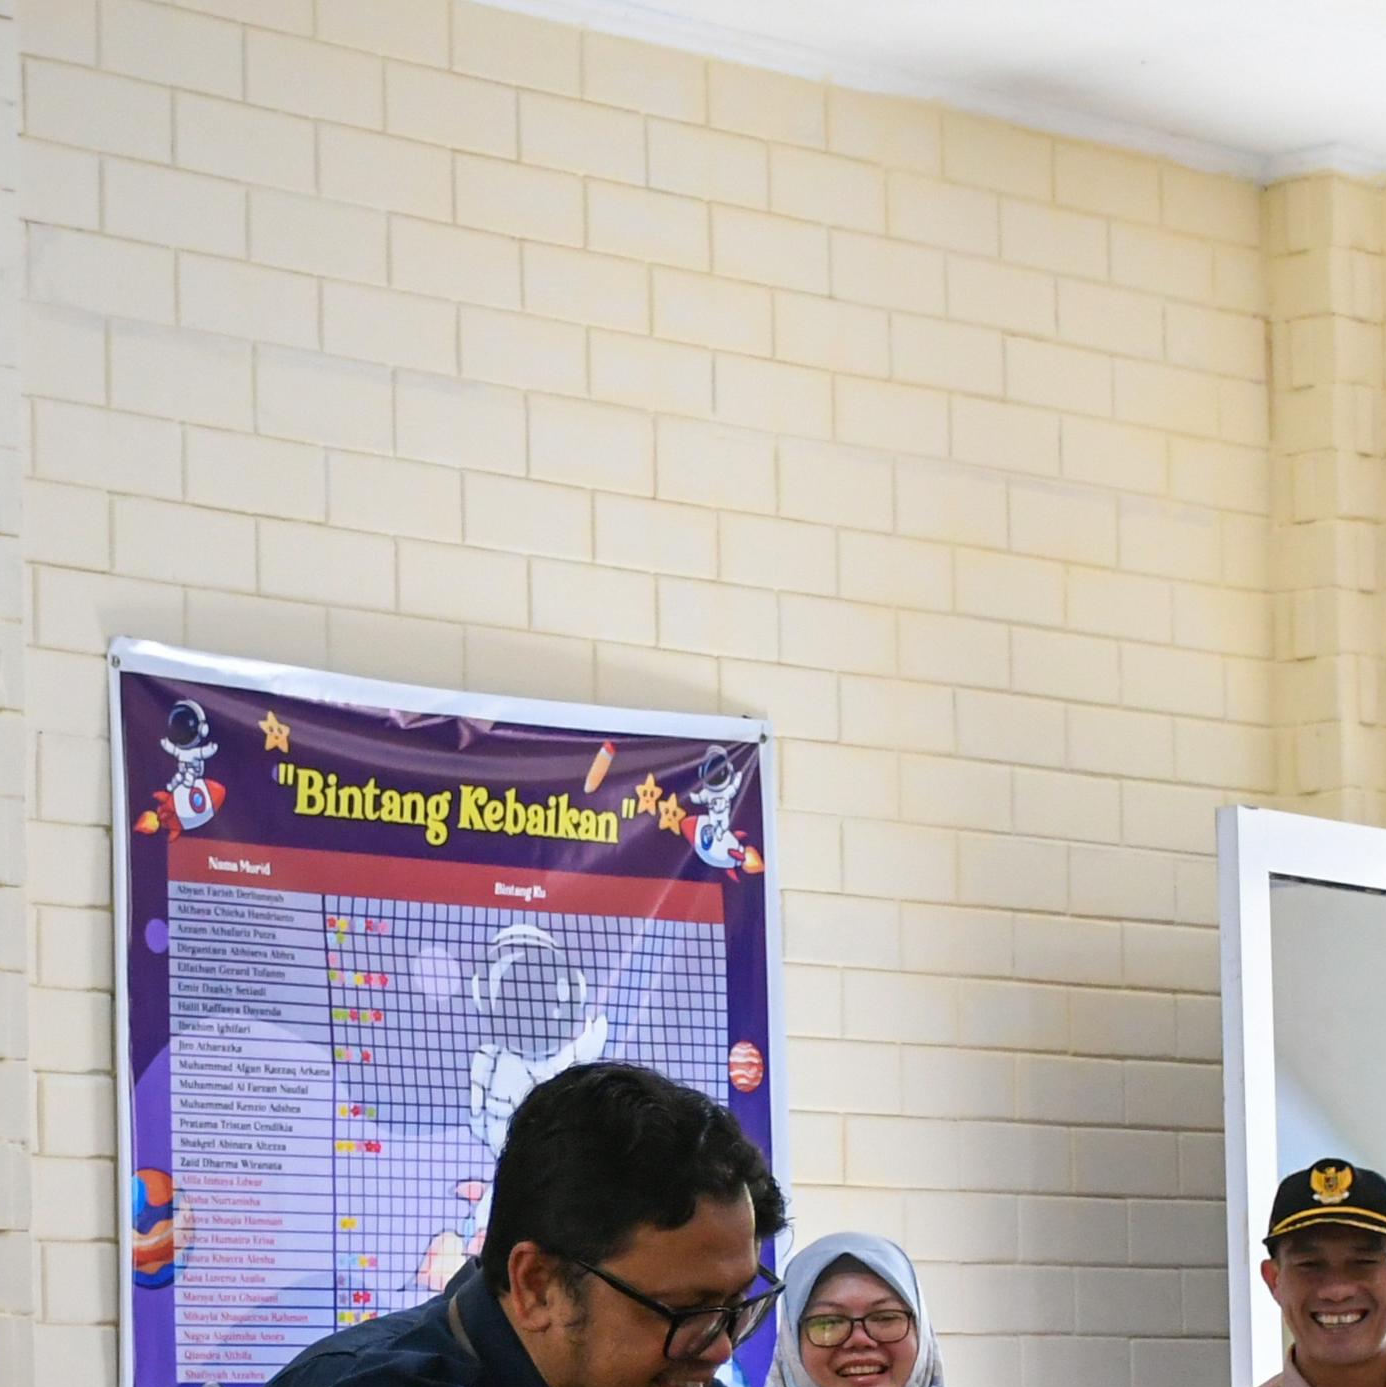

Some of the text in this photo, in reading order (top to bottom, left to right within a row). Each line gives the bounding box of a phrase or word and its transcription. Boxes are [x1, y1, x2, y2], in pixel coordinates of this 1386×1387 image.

[278, 763, 635, 846] "Bintang Kebaikan"
[208, 856, 271, 875] Nama Murid
[495, 882, 532, 902] Bintang
[179, 1060, 232, 1071] Muhammad
[179, 1080, 233, 1091] Muhammad
[179, 1099, 234, 1110] Muhammad
